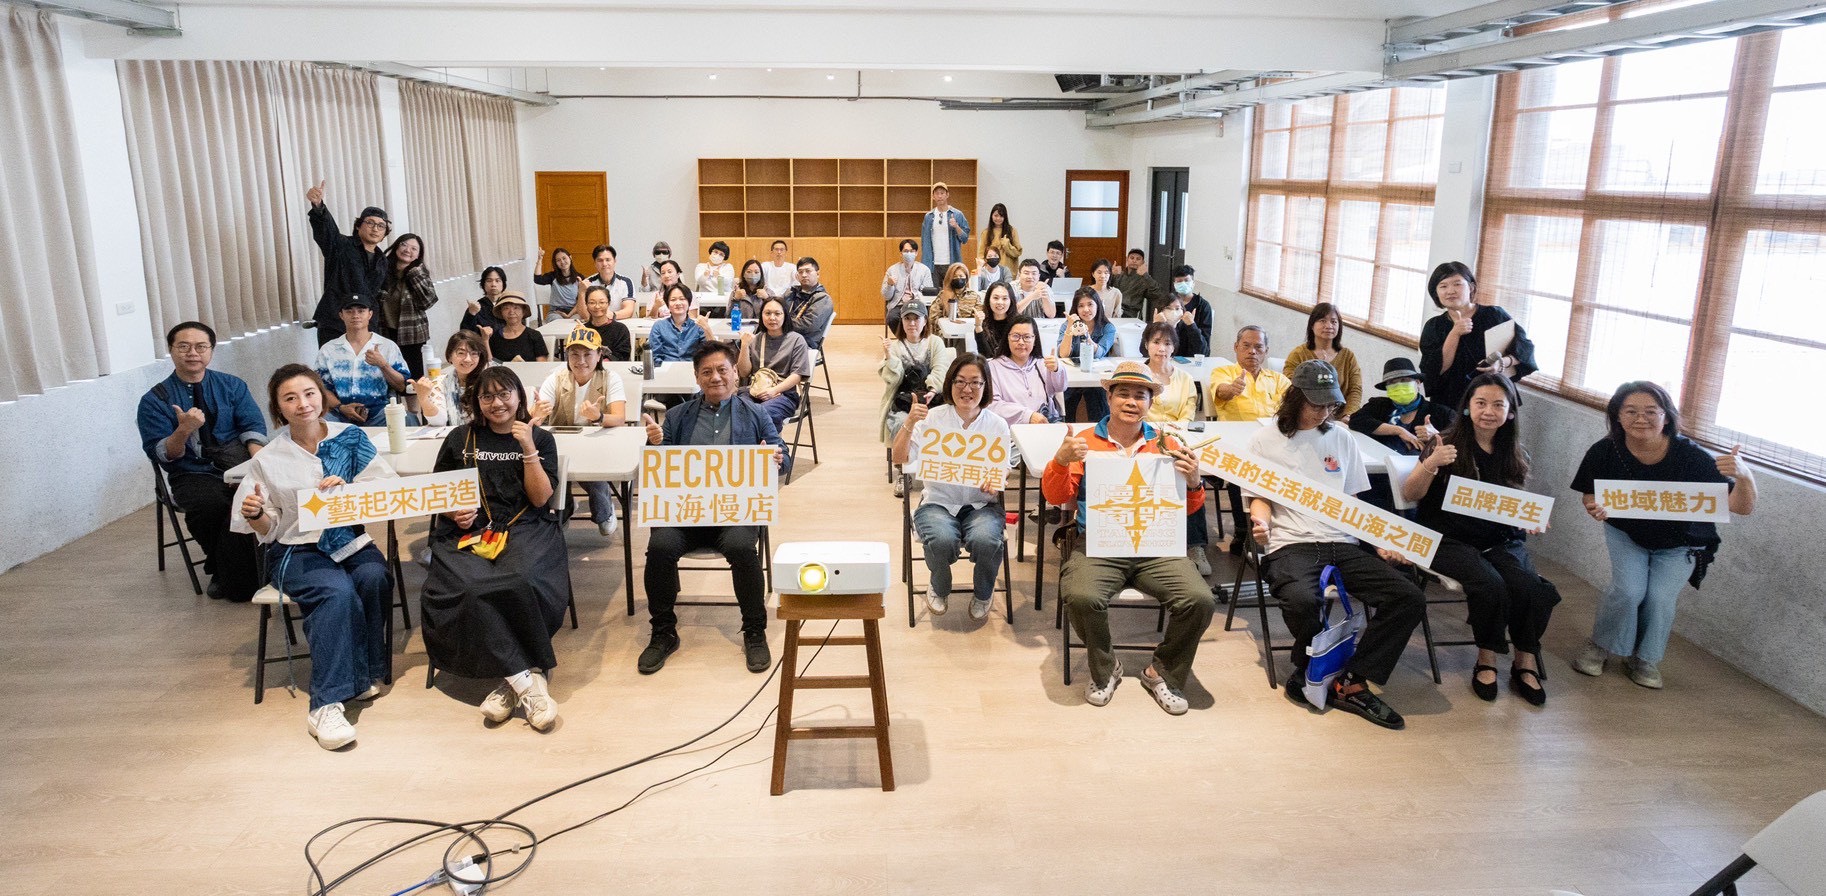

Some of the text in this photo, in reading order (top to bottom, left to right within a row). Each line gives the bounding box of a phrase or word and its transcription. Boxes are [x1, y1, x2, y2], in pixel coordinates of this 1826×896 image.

[571, 329, 595, 343] NYC
[921, 428, 1006, 464] 2026
[642, 449, 775, 488] RECRUIT
[918, 459, 1003, 489] 店家再造
[326, 479, 478, 525] 藝起來店造
[642, 493, 775, 524] 山海慢店
[1199, 444, 1434, 558] 台東的生活就是山海之間
[1450, 486, 1543, 524] 品牌再生
[1602, 488, 1717, 514] 地域魅力
